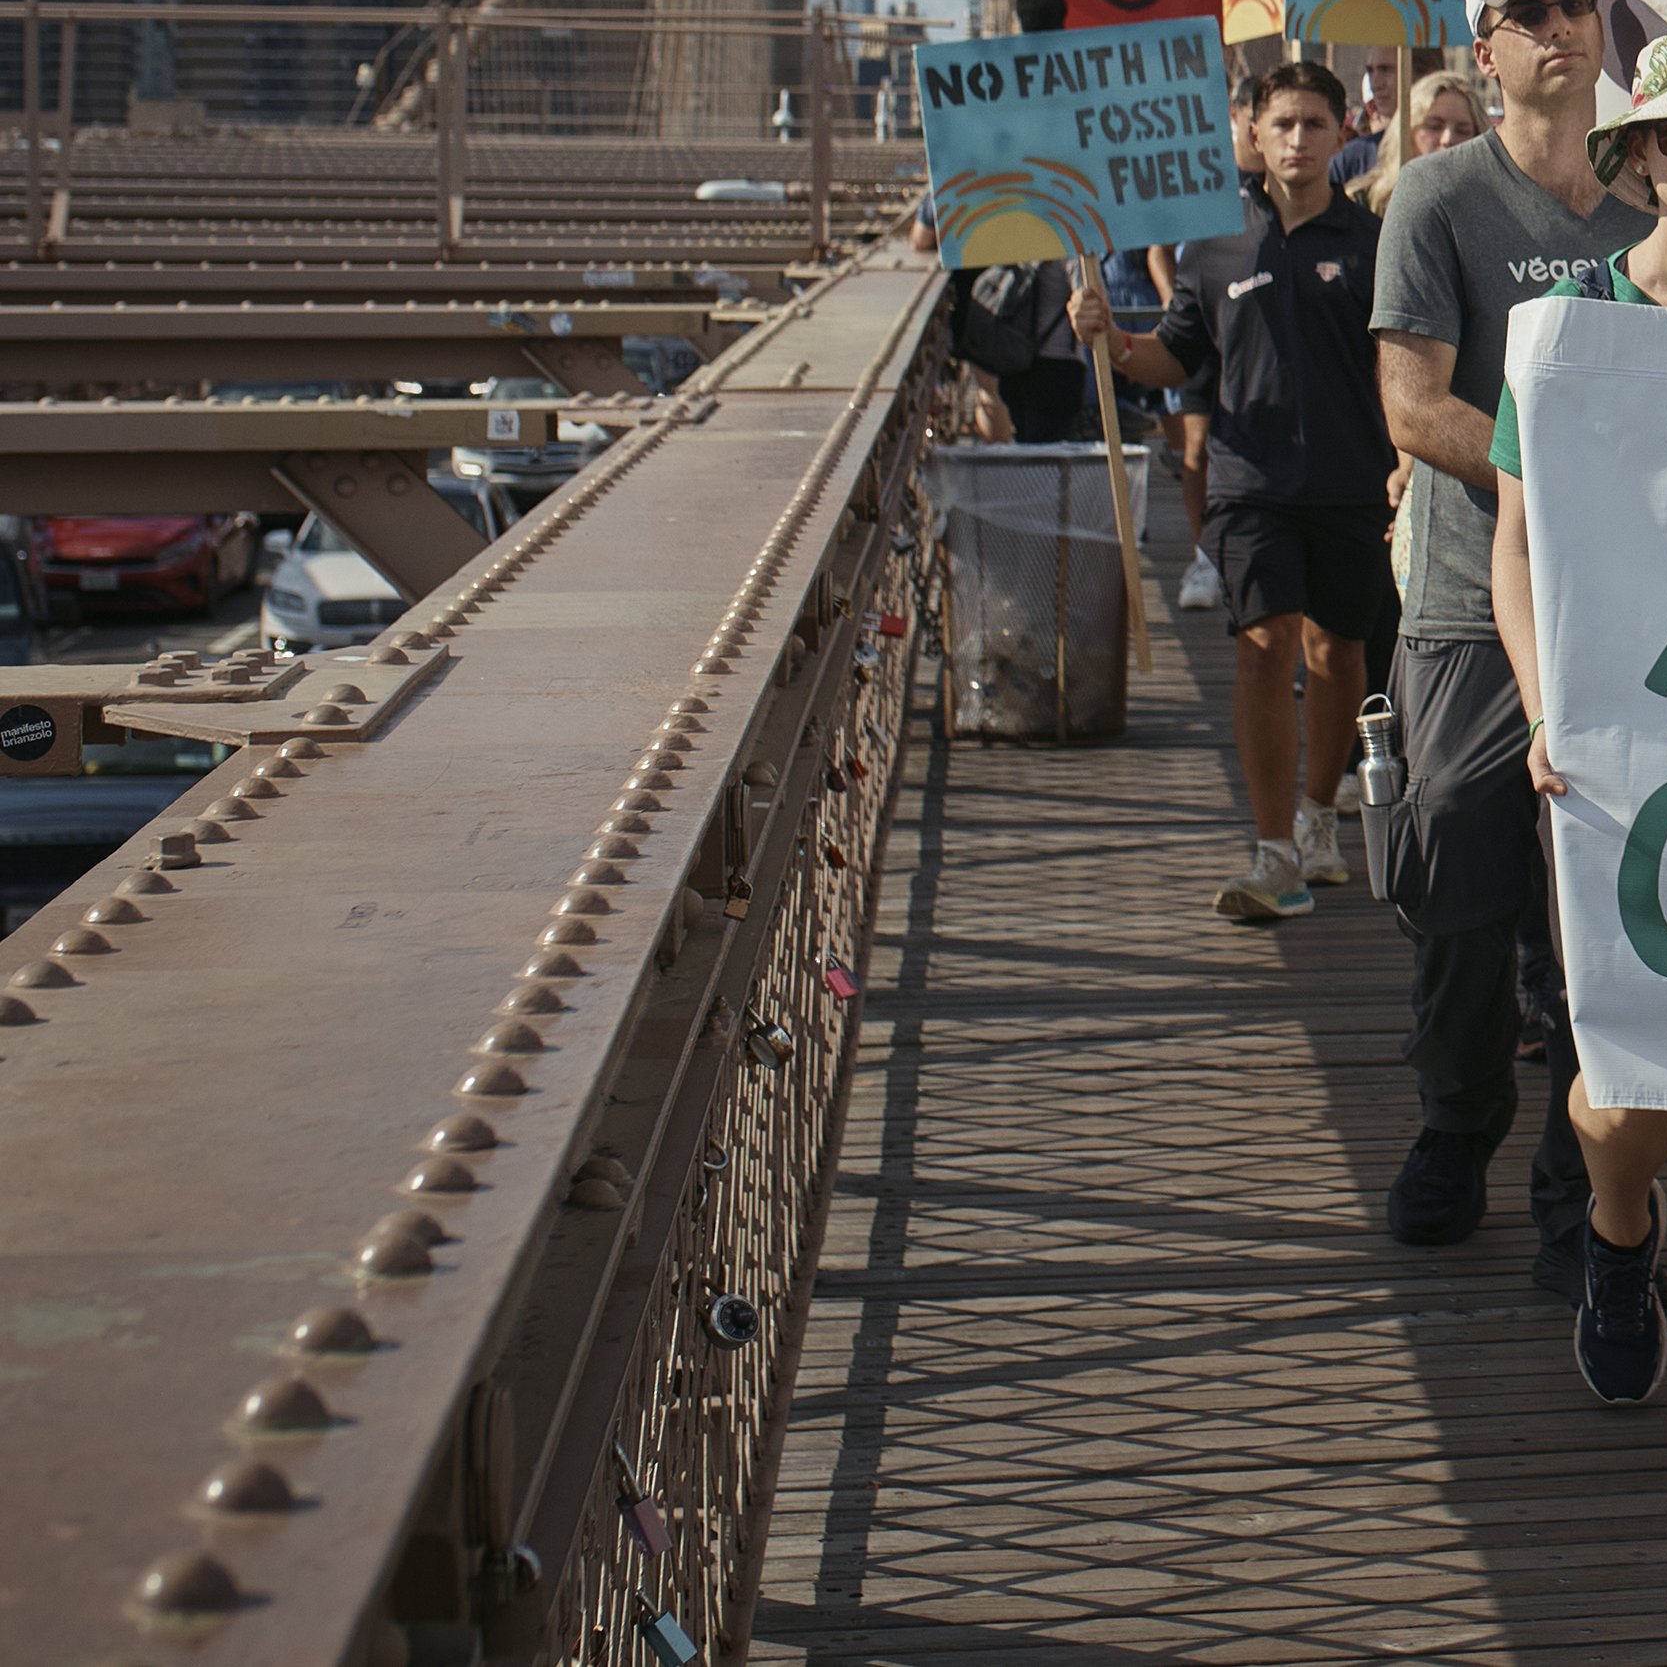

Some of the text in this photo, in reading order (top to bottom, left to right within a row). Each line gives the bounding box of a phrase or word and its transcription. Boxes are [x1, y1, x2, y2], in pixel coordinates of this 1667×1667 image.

[925, 35, 1209, 109] NO FAITH IN
[1075, 94, 1215, 149] FOSSIL
[1107, 147, 1226, 206] FUELS
[0, 720, 52, 738] manifesto
[1, 729, 53, 747] brianzolo
